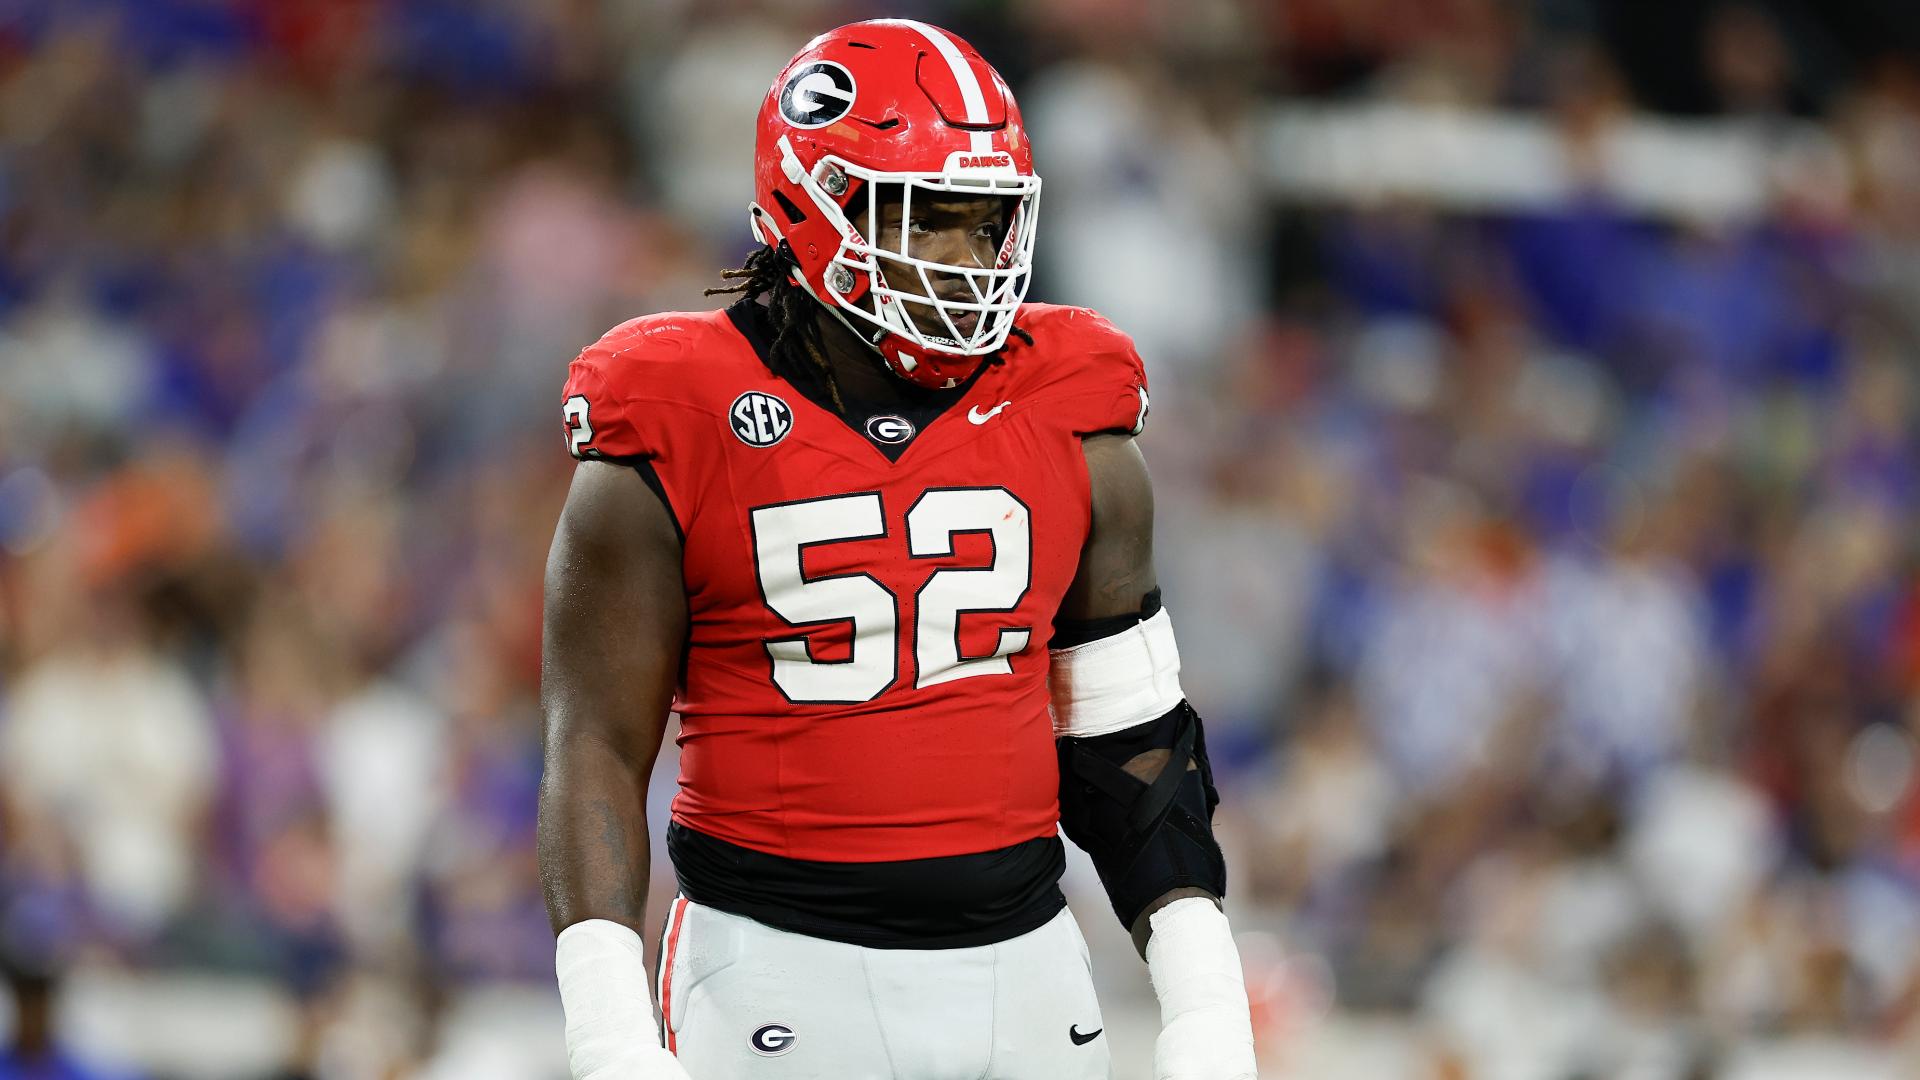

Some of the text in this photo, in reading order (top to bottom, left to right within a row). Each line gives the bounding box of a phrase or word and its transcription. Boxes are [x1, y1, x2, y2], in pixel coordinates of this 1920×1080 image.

[783, 65, 853, 123] G
[959, 155, 1010, 168] DAWGS
[563, 393, 601, 460] 2
[734, 394, 788, 443] SEC
[869, 418, 911, 442] G
[749, 486, 1032, 705] 52
[753, 1025, 796, 1051] G
